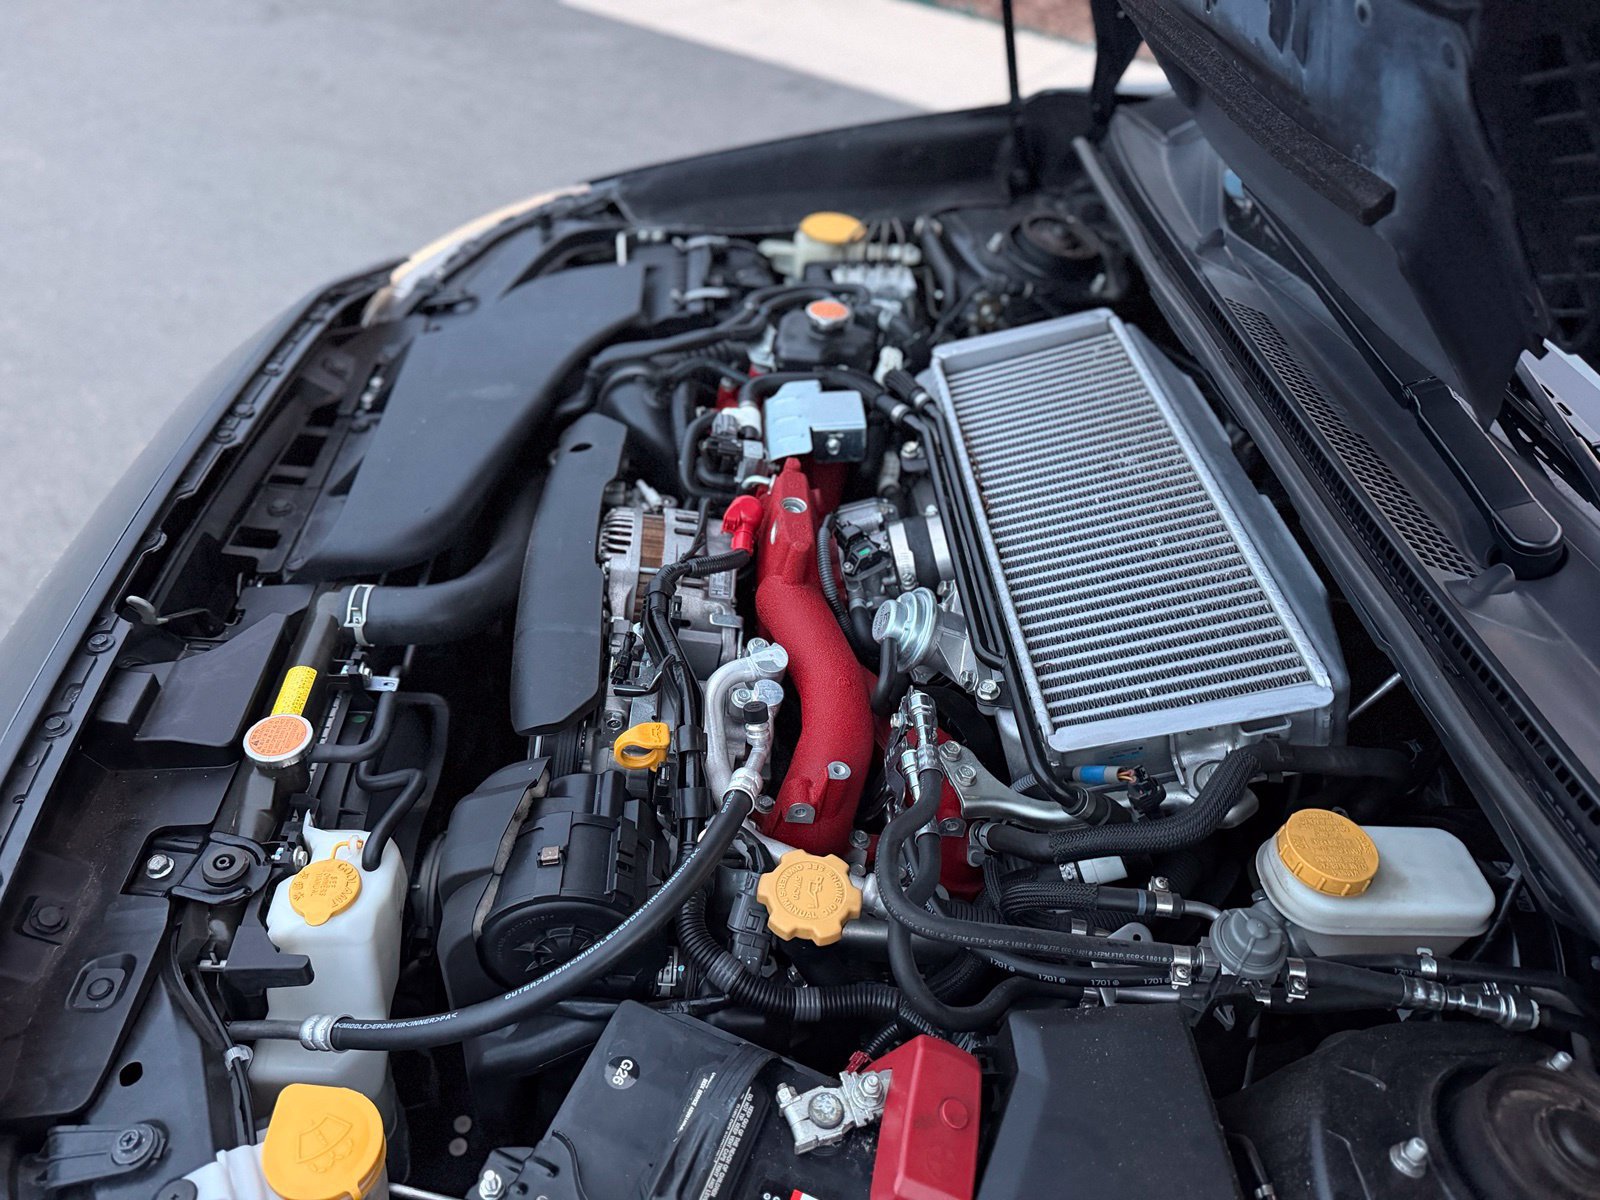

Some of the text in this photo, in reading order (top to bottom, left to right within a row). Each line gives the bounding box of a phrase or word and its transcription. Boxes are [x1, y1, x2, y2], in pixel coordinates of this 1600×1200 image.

[337, 862, 357, 908] COOLANT
[822, 869, 844, 916] ENGINE OIL
[782, 899, 817, 918] MANUAL
[990, 958, 1008, 970] 1701
[1038, 973, 1058, 982] 1701
[612, 1060, 633, 1086] G26
